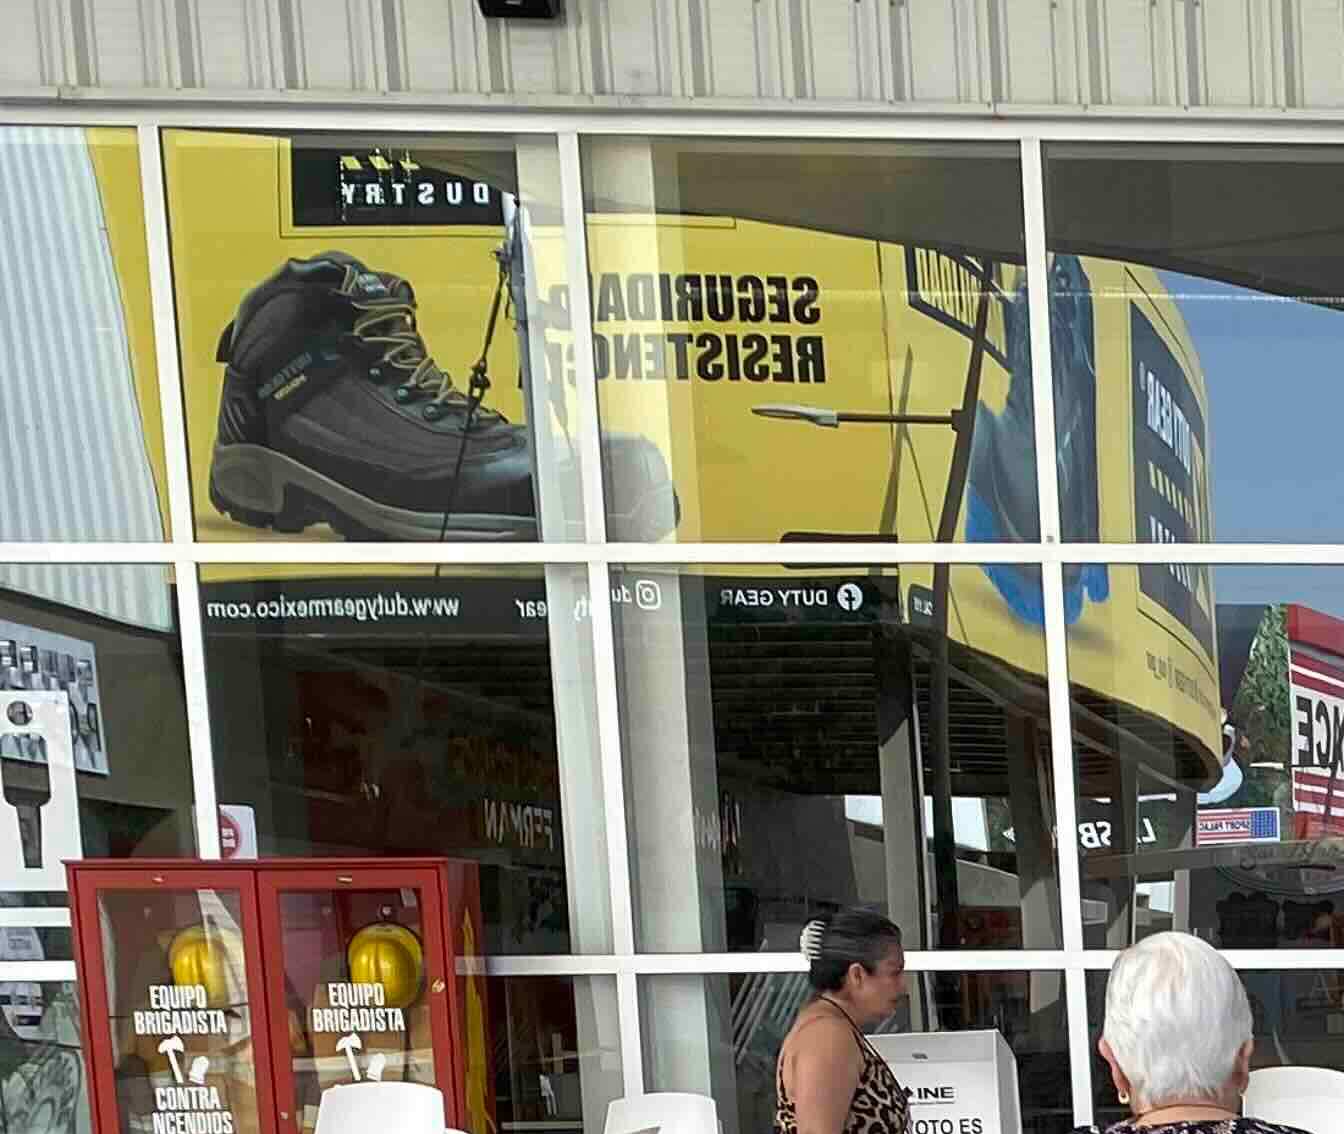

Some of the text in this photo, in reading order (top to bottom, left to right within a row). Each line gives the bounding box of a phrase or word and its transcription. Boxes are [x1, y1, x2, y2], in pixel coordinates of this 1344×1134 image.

[149, 984, 207, 1009] EQUIPO
[328, 982, 384, 1007] EQUIPO
[134, 1010, 228, 1036] BRIGADISTA
[313, 1007, 406, 1033] BRIGADISTA
[155, 1086, 222, 1112] CONTRA
[917, 1086, 955, 1099] INE
[959, 1118, 983, 1134] ES
